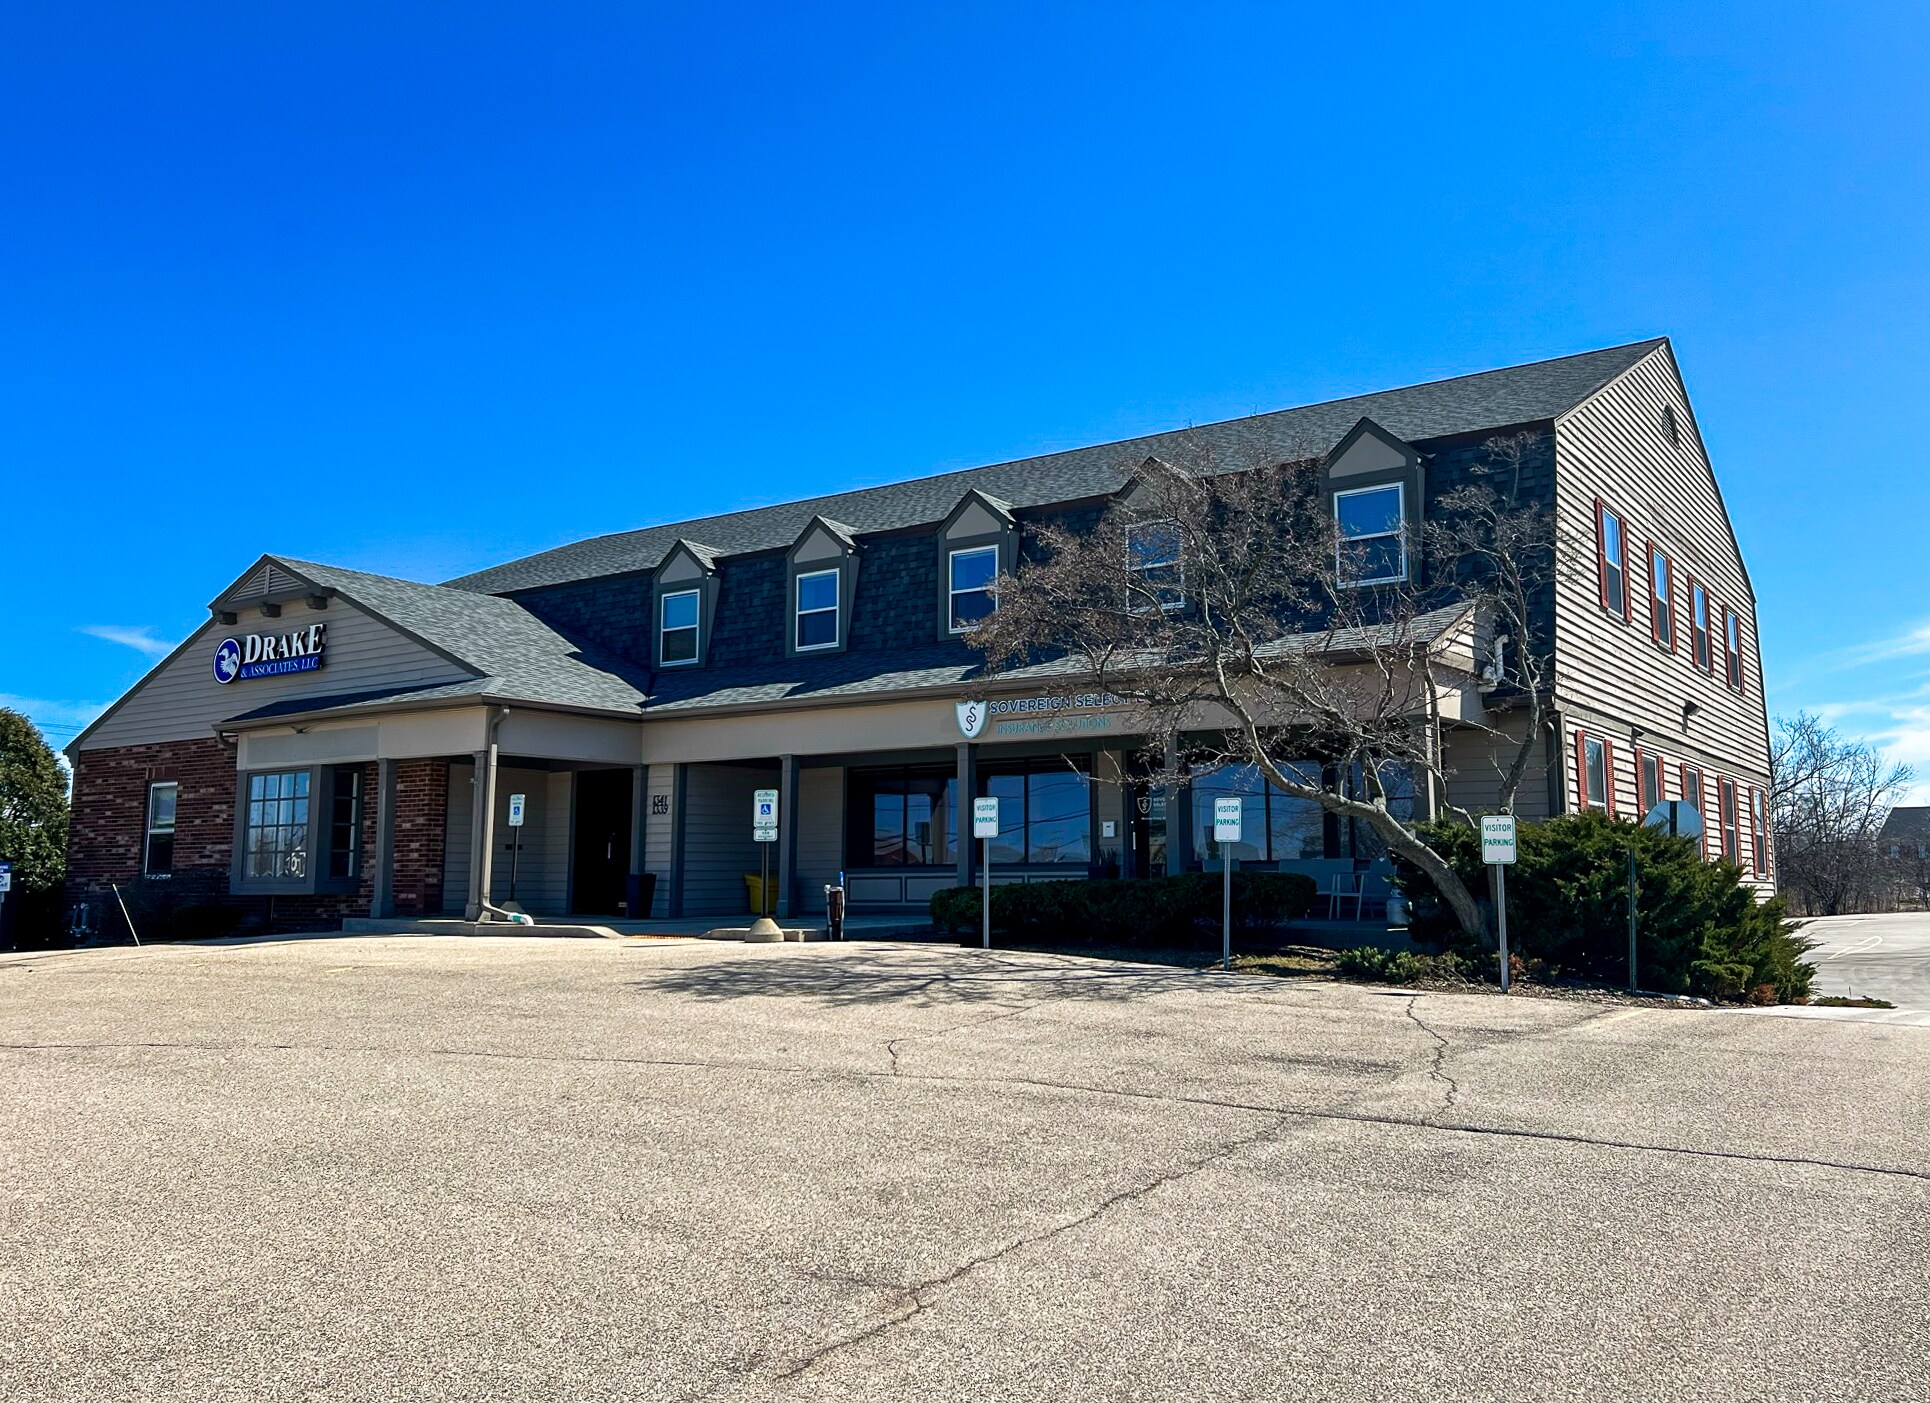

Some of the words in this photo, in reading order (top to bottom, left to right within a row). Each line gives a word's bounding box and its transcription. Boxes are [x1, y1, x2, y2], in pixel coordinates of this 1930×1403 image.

[242, 623, 324, 664] DRAKE
[240, 668, 248, 678] &
[301, 656, 318, 670] LLC
[990, 696, 1071, 715] SOVEREIGN
[1215, 818, 1239, 826] PARKING
[1484, 823, 1512, 831] VISITOR
[1484, 838, 1514, 846] PARKING
